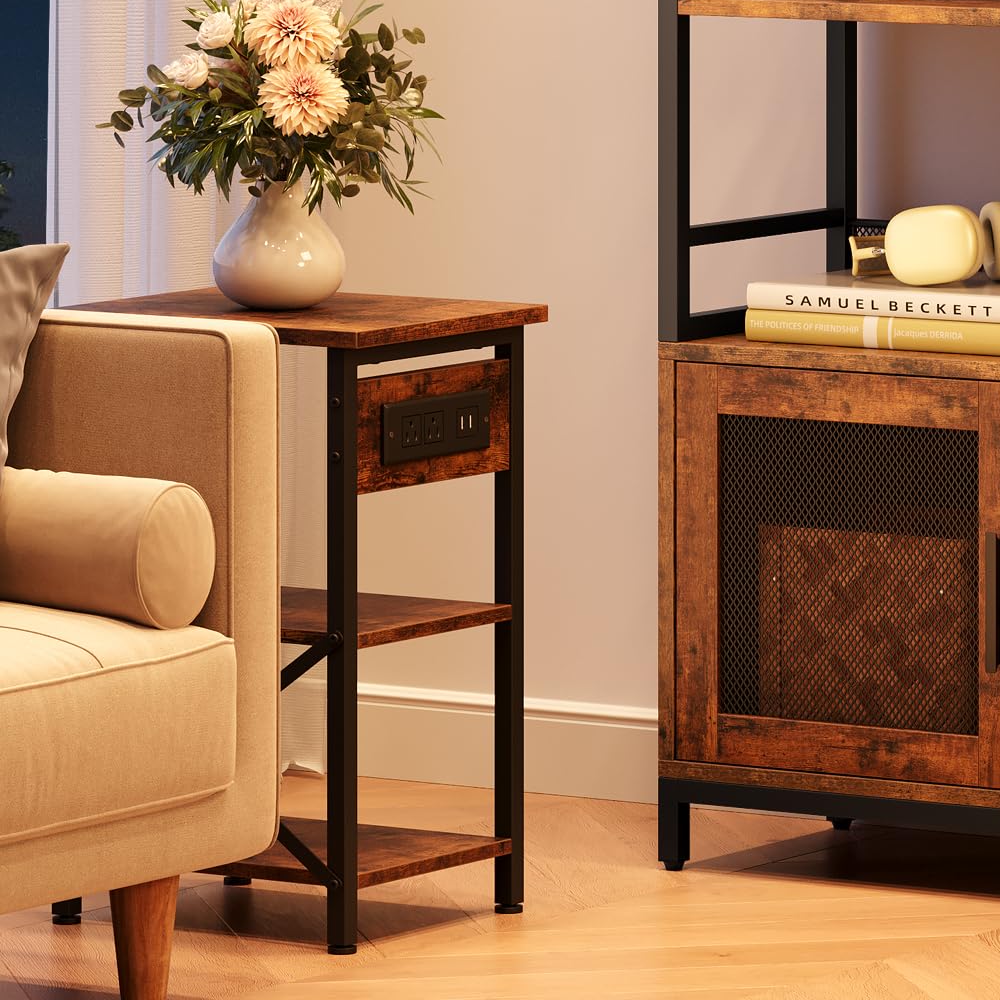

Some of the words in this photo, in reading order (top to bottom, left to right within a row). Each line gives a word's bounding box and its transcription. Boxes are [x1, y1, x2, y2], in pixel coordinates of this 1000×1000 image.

[786, 294, 879, 310] SAMUEL
[889, 301, 993, 317] BECKETT
[750, 320, 765, 329] THE
[803, 323, 813, 331] OF
[815, 324, 859, 333] FRIENDSHIP
[929, 330, 963, 339] DERRIDA
